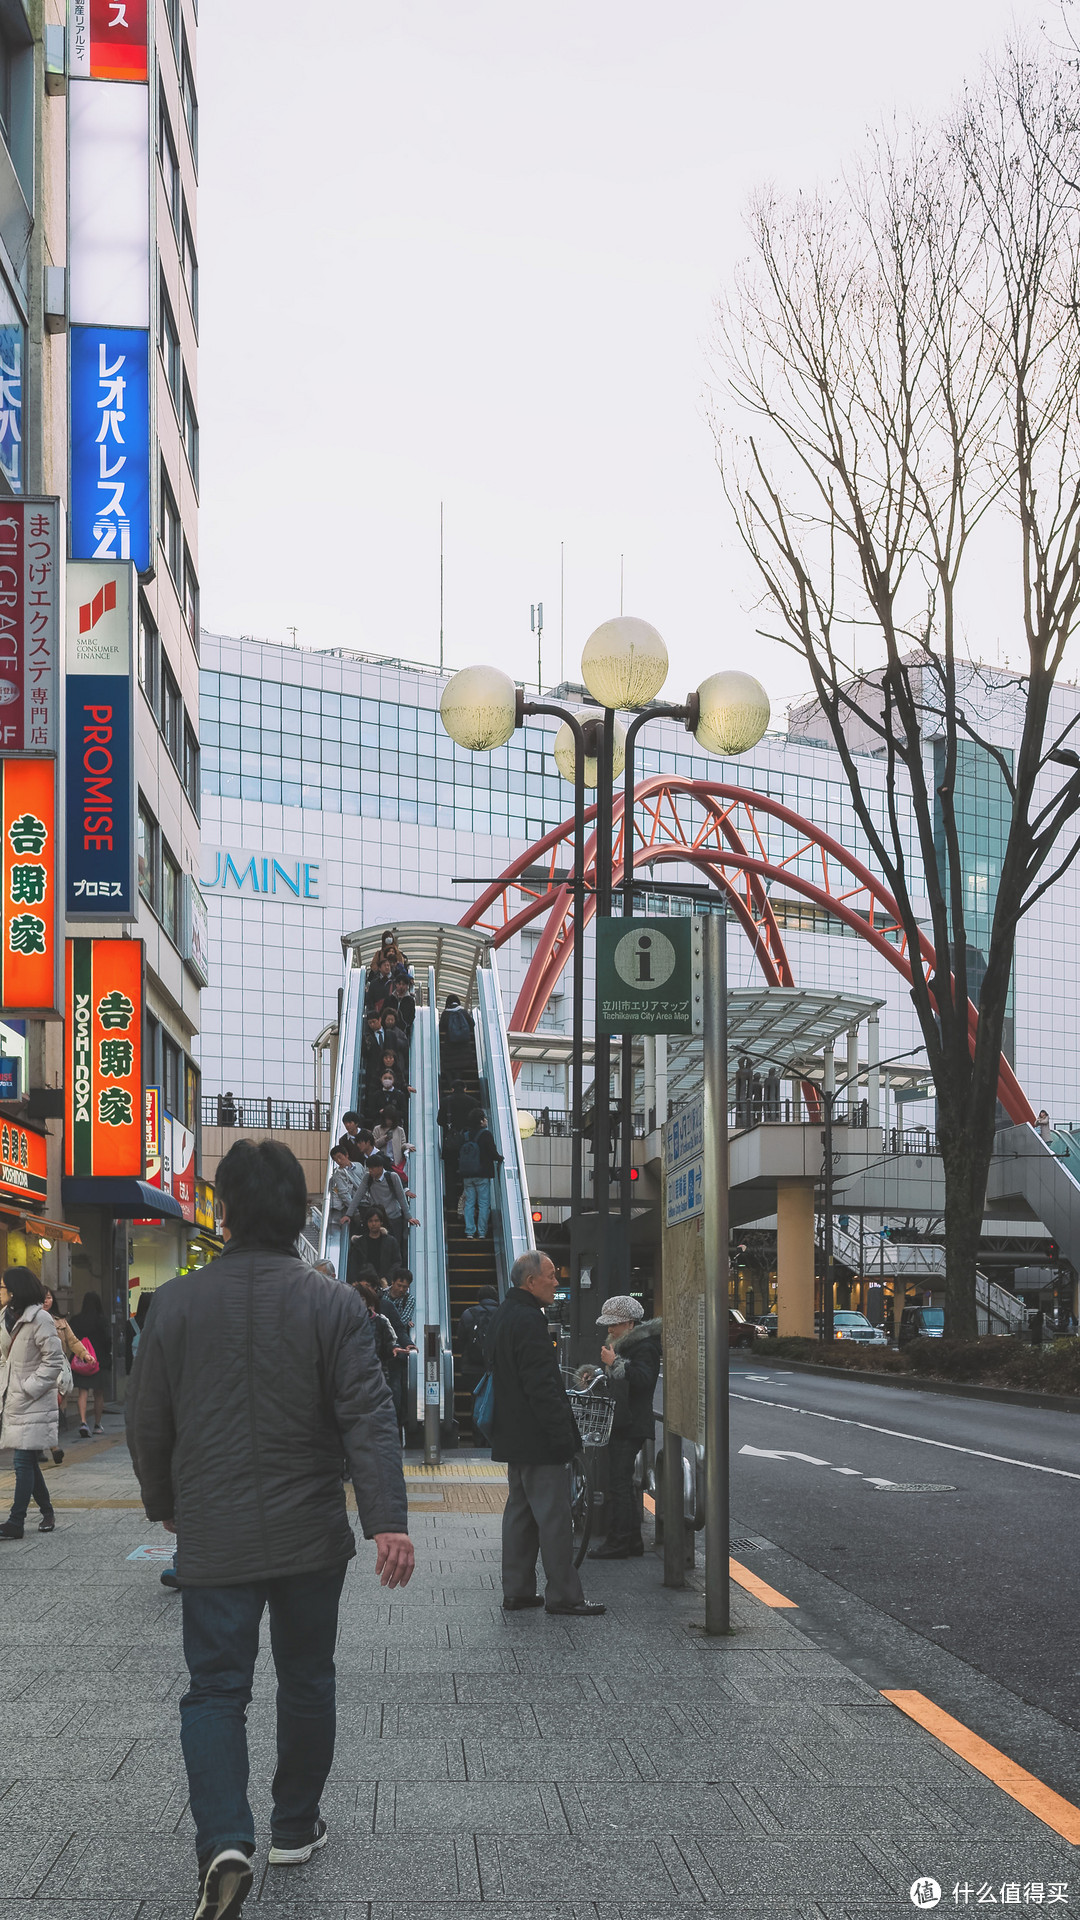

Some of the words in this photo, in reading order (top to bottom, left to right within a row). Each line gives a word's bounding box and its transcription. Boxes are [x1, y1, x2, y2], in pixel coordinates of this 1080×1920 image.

[28, 513, 52, 744] まつげエクステ専門店
[83, 705, 113, 851] PROMISE
[73, 880, 123, 897] プロミス
[602, 1000, 689, 1011] 立川市エリアマップ
[602, 1011, 640, 1020] Tachikawa
[640, 1011, 655, 1022] City
[656, 1011, 673, 1020] Area
[674, 1011, 690, 1022] Map
[75, 994, 90, 1122] YOSHINOYA
